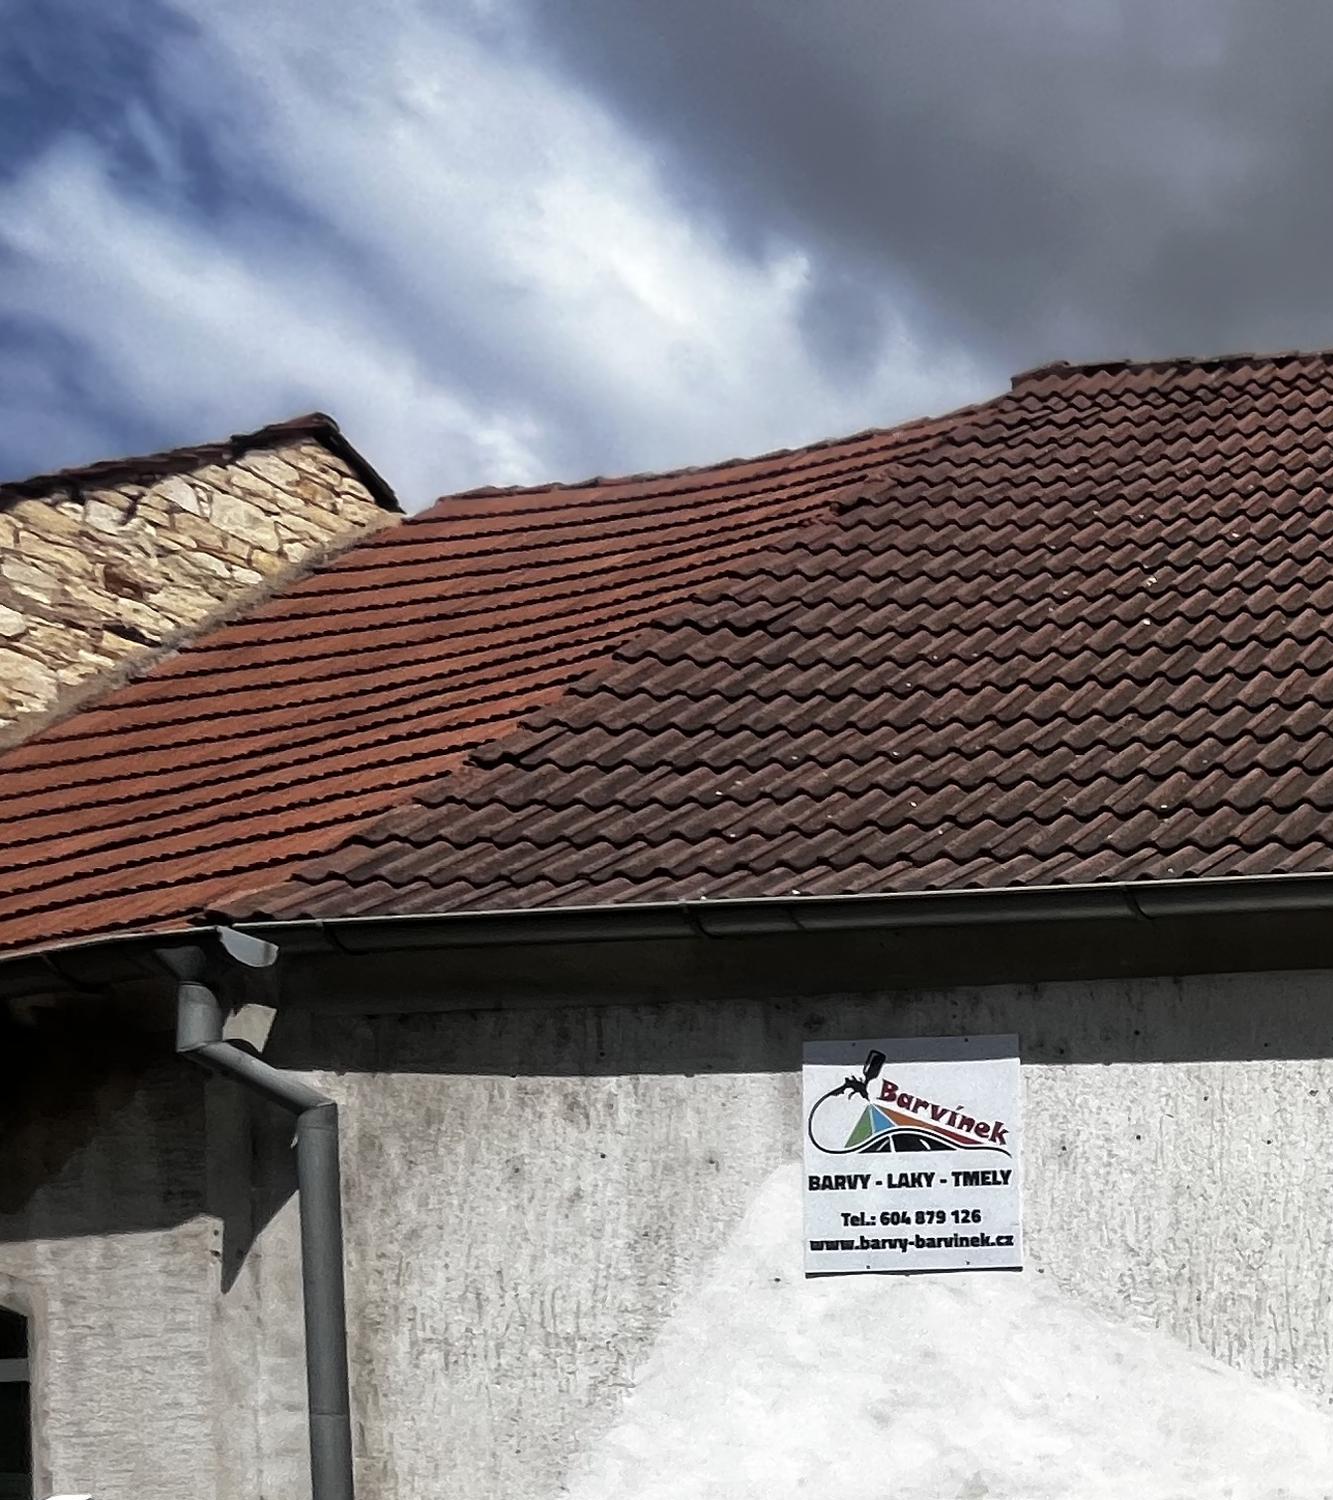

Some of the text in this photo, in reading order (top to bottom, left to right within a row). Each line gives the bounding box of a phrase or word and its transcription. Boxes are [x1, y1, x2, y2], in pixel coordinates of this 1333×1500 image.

[877, 1078, 1009, 1145] Barvínek
[808, 1174, 871, 1191] BARVY
[887, 1172, 935, 1189] LAKY
[951, 1170, 1012, 1187] TMELY
[841, 1209, 982, 1227] Tel.: 604 879 126
